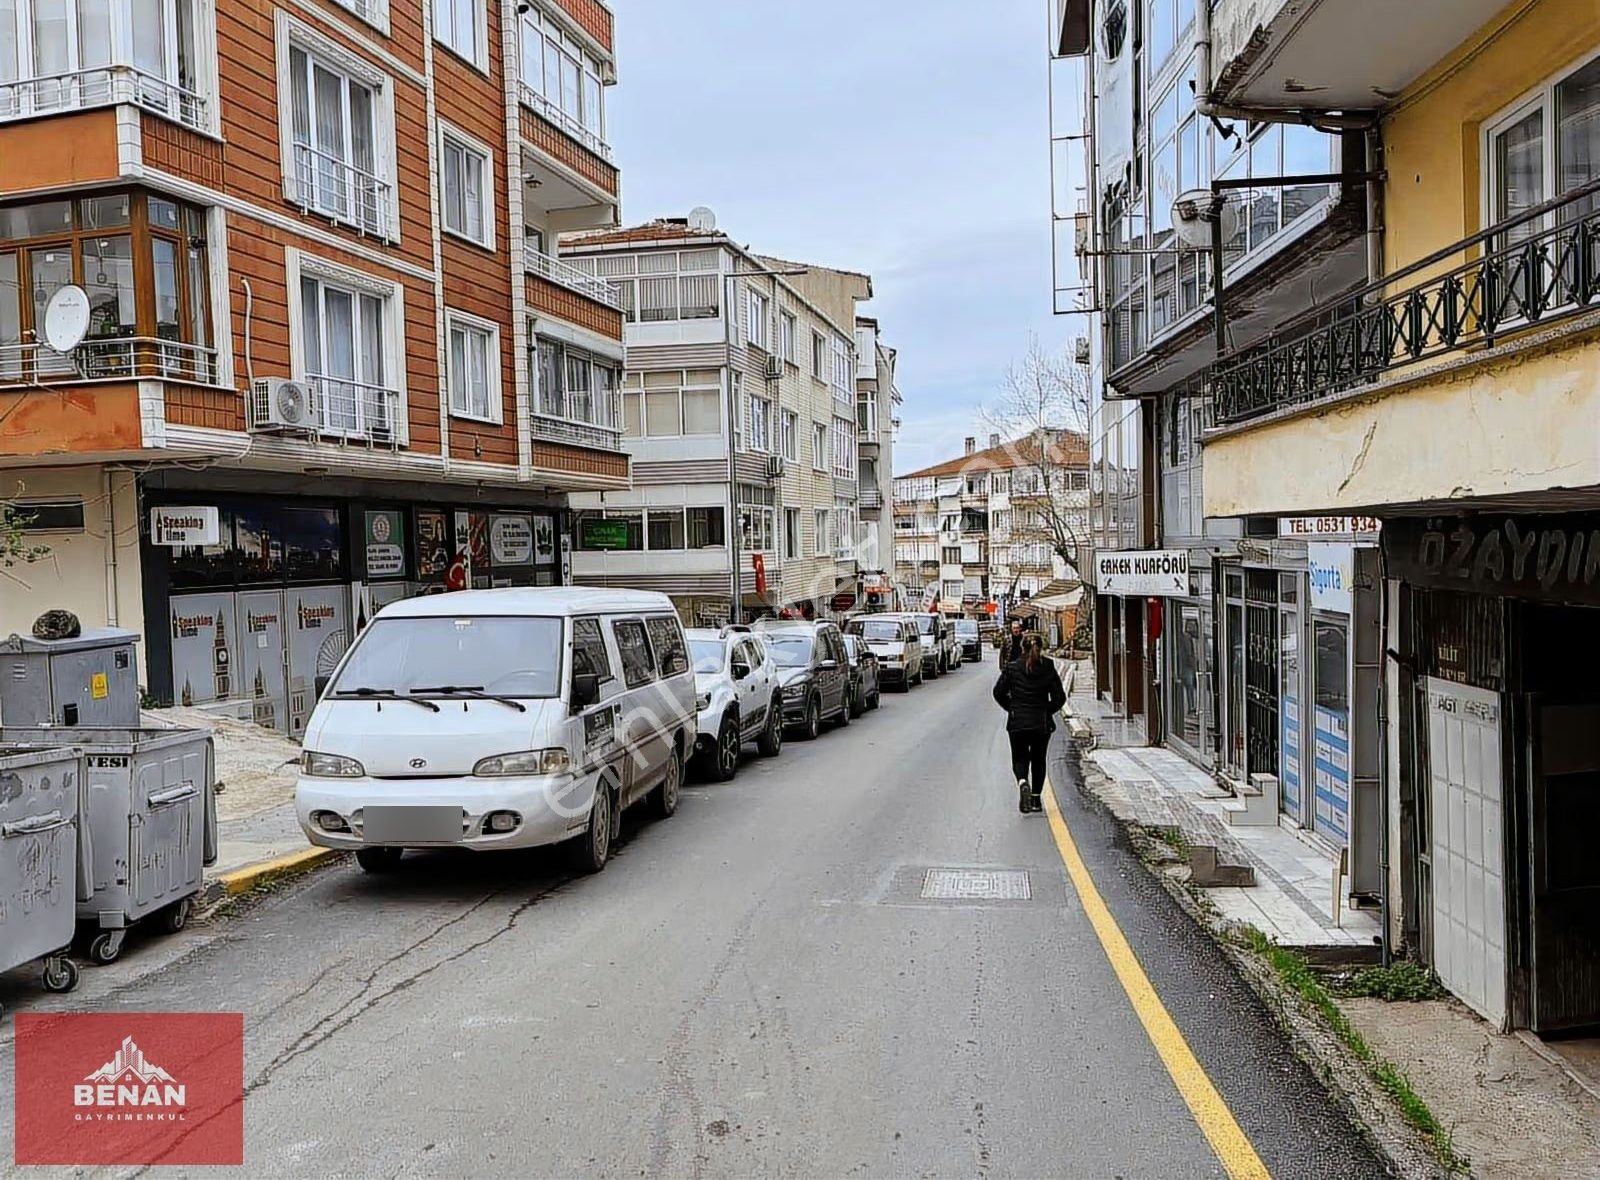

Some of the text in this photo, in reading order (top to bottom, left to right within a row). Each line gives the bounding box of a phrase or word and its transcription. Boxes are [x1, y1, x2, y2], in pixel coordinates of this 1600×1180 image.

[163, 515, 204, 529] Speaking
[1289, 516, 1377, 533] TEL: 0531 934
[166, 528, 186, 541] time
[1100, 553, 1187, 575] ERKEK KUAFÖRÜ
[303, 606, 335, 619] Speaking
[178, 614, 213, 628] Speaking
[181, 627, 199, 637] time
